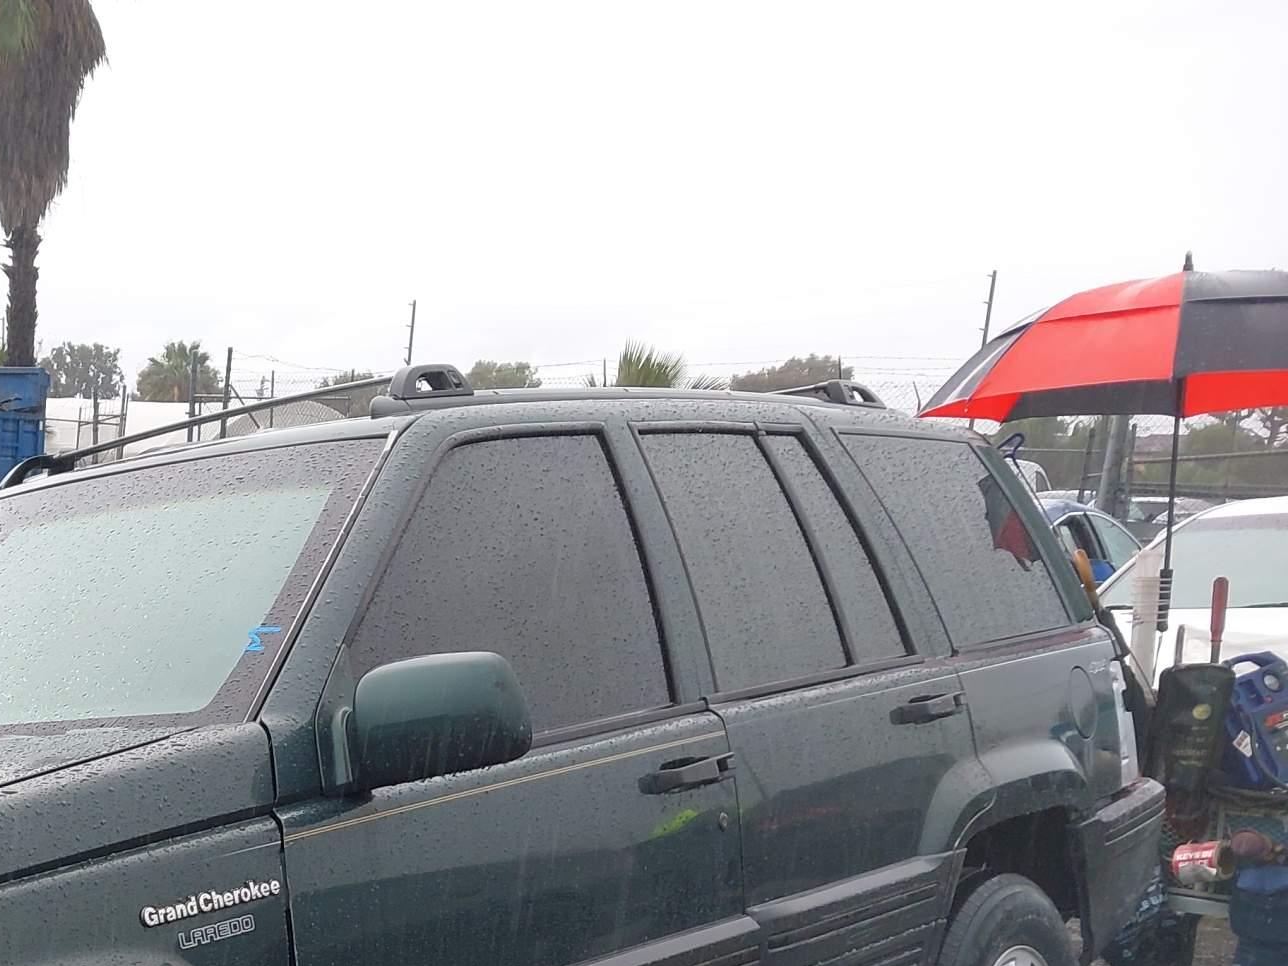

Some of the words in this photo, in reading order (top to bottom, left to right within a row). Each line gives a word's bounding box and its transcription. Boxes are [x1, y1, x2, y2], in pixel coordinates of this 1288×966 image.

[142, 895, 199, 927] Grand
[199, 879, 281, 912] Cherokee
[178, 914, 256, 949] LAREDO
